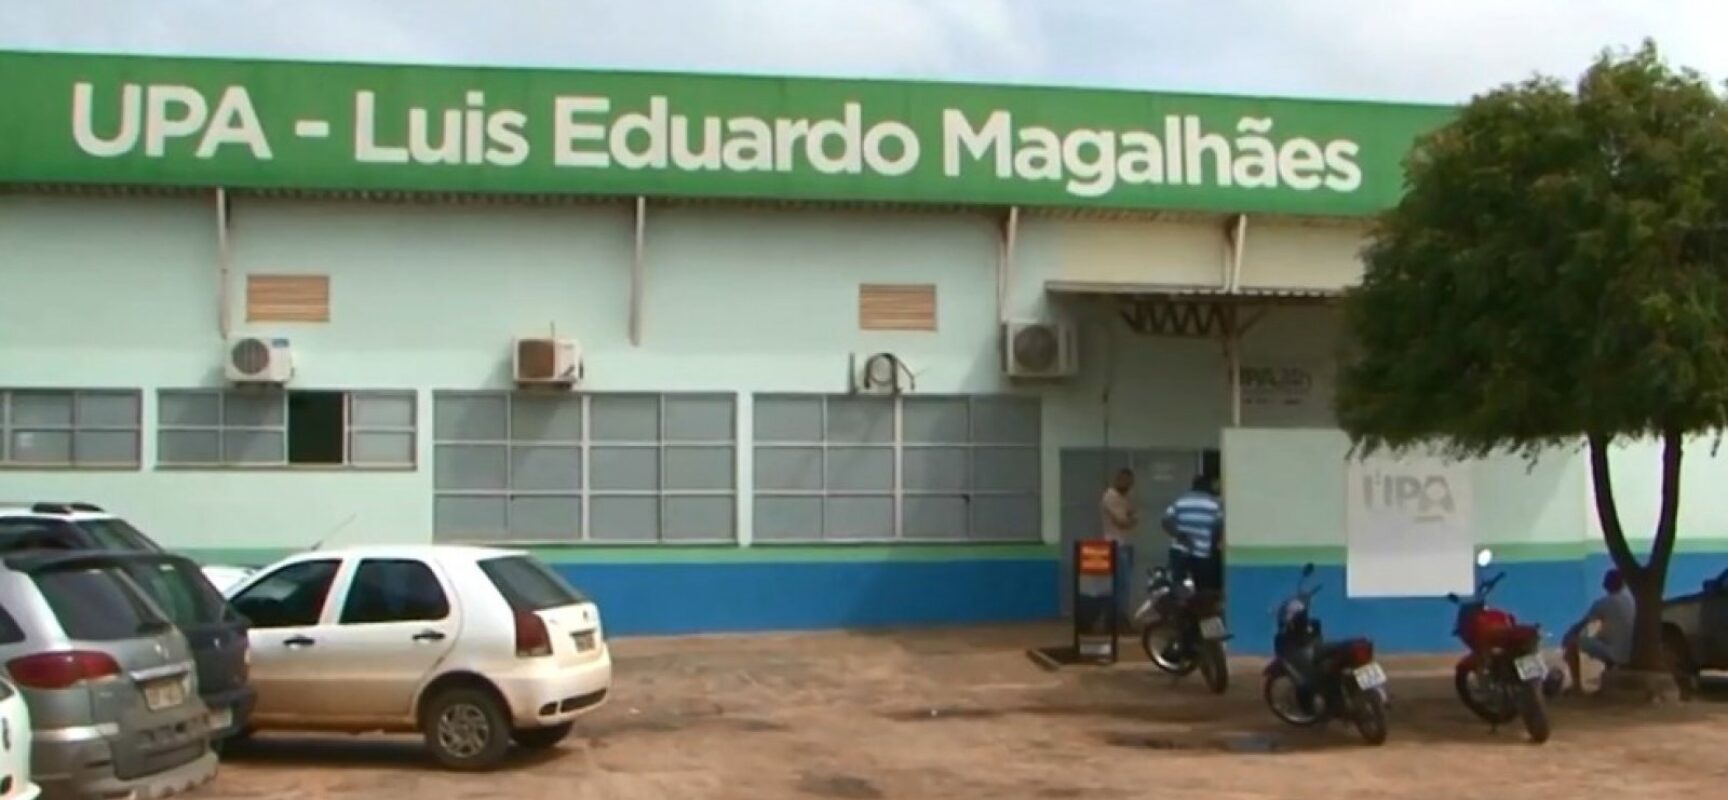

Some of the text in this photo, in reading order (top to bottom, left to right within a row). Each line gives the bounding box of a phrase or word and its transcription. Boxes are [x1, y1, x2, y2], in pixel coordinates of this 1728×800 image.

[71, 81, 1363, 198] UPA - Luis Eduardo Magalhães
